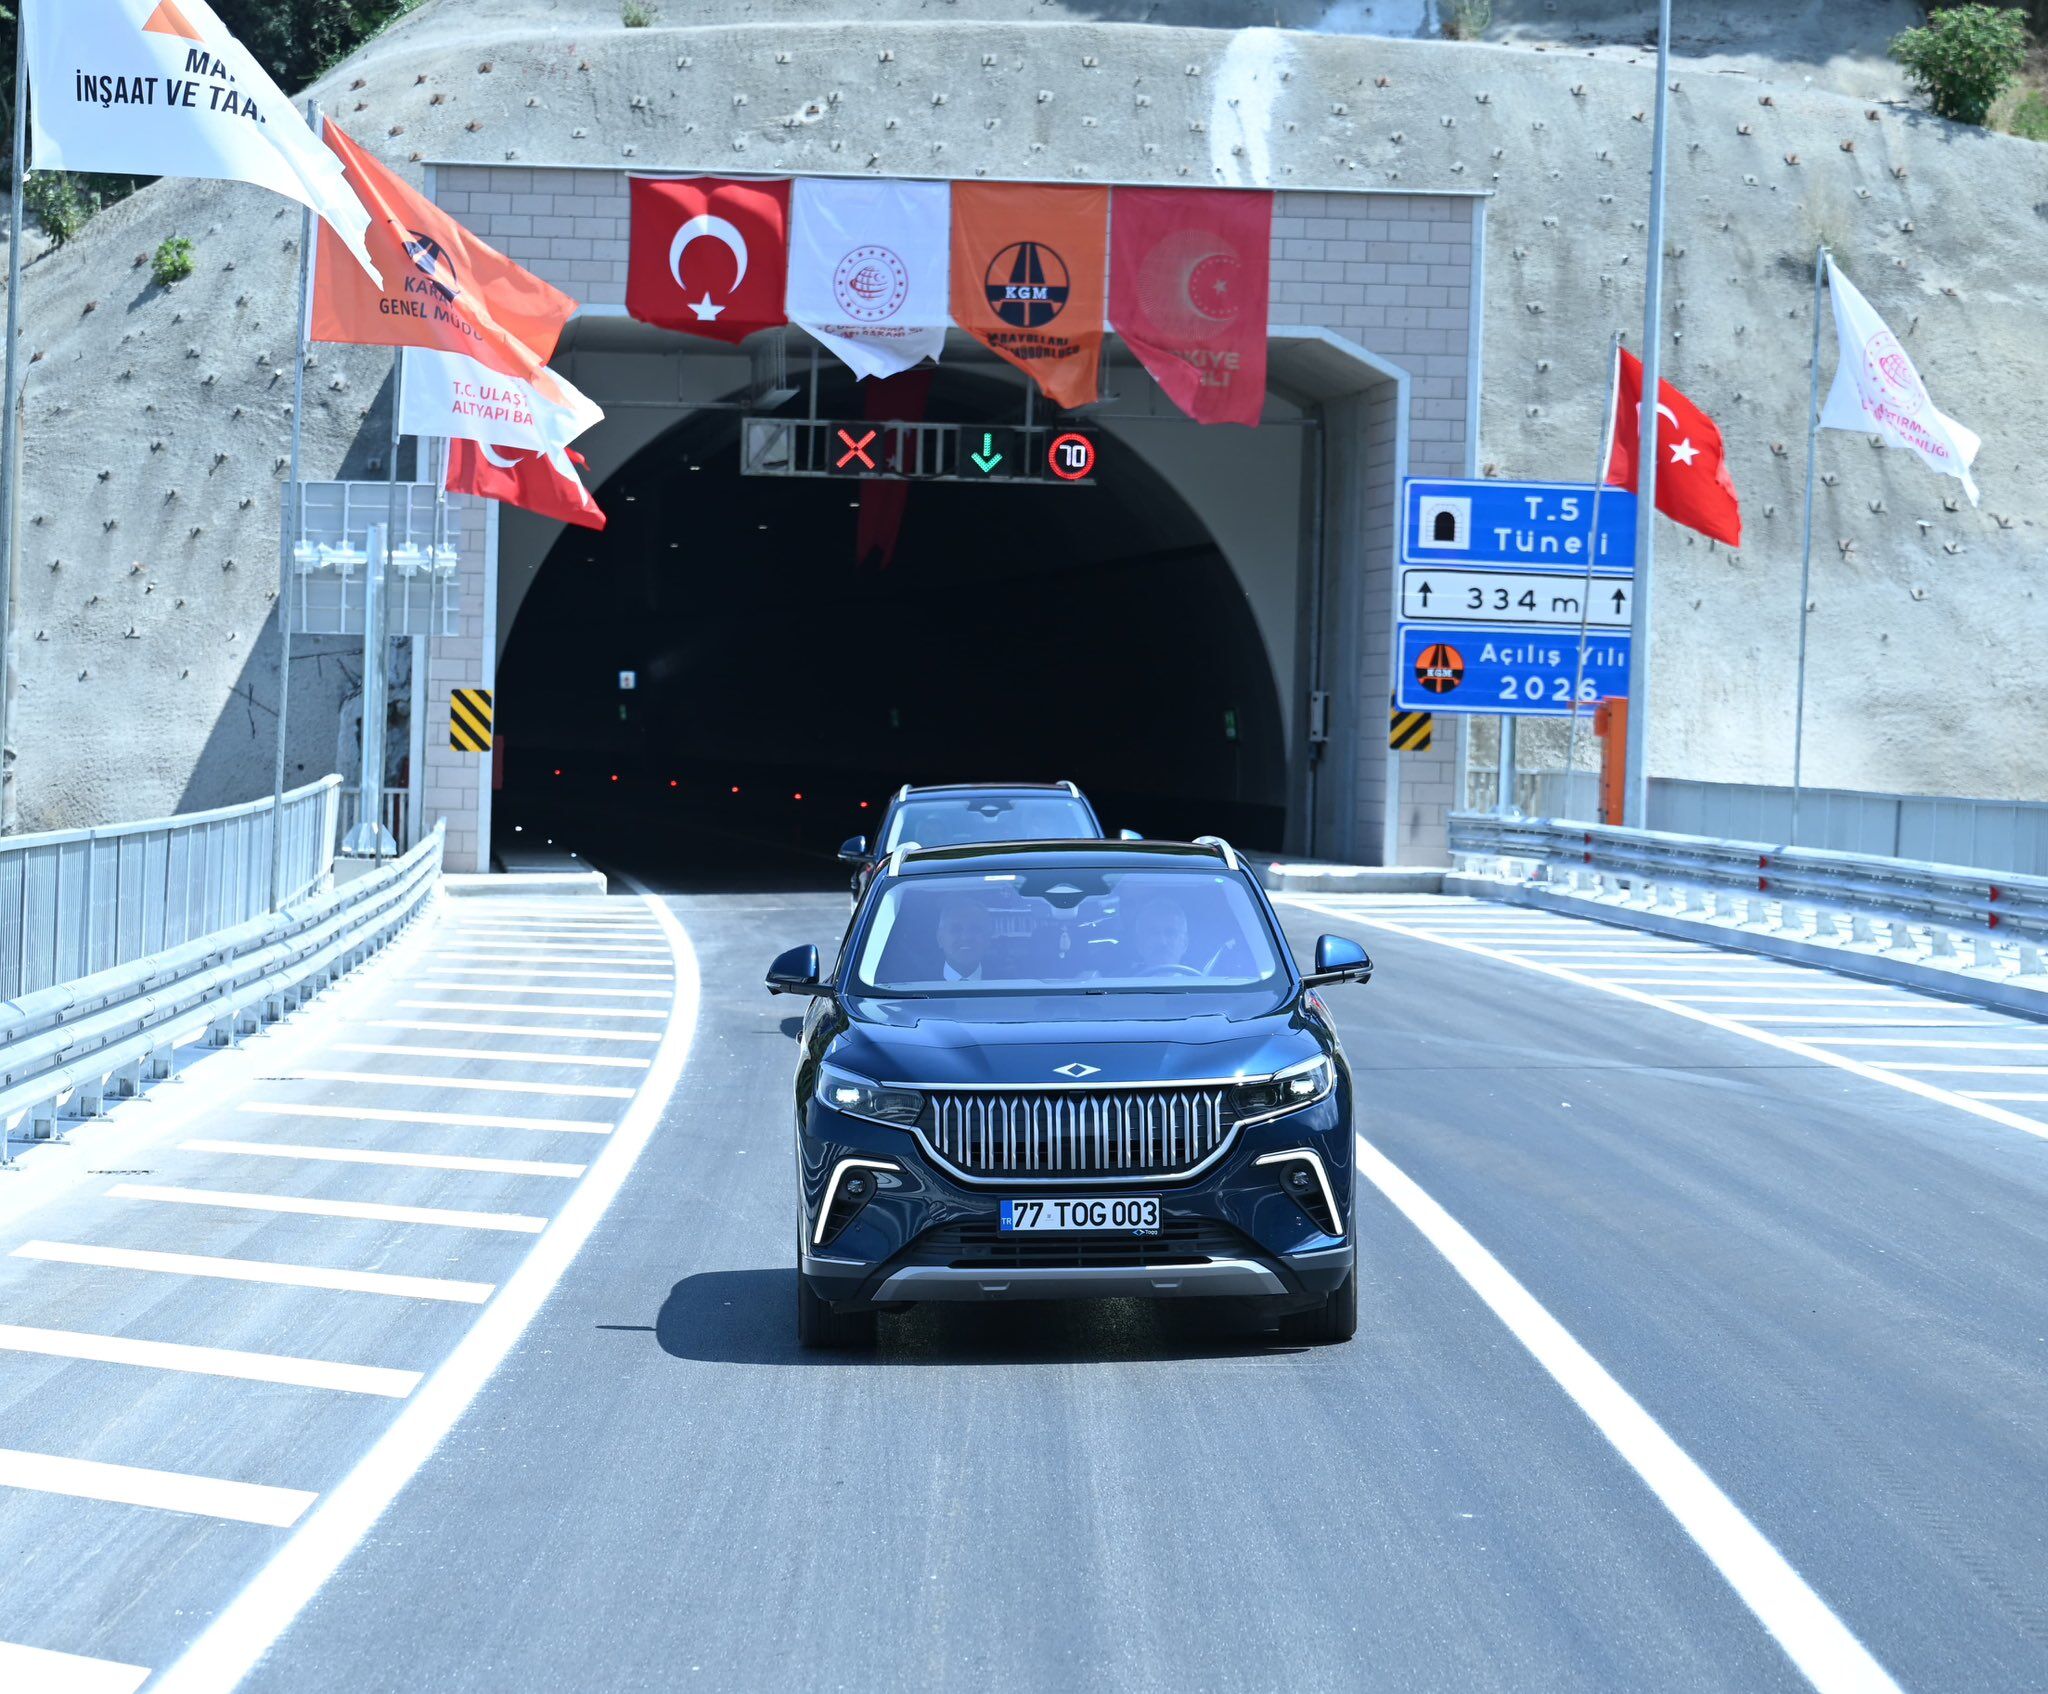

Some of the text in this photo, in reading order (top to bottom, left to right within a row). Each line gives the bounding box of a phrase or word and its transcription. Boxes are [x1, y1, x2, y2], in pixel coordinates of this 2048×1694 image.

[185, 48, 236, 83] MA
[76, 69, 158, 108] İNŞAAT
[167, 79, 200, 108] VE
[404, 276, 455, 308] KARA
[1005, 286, 1048, 300] KGM
[380, 298, 428, 319] GENEL
[452, 400, 509, 422] ALTYAPI
[1059, 444, 1086, 467] 70
[1524, 496, 1580, 522] T.5
[1467, 587, 1579, 613] 334 m
[1479, 643, 1561, 667] Açılış
[1499, 676, 1598, 702] 2026
[1001, 1217, 1012, 1225] TR
[1014, 1201, 1157, 1228] 77 TOG 003
